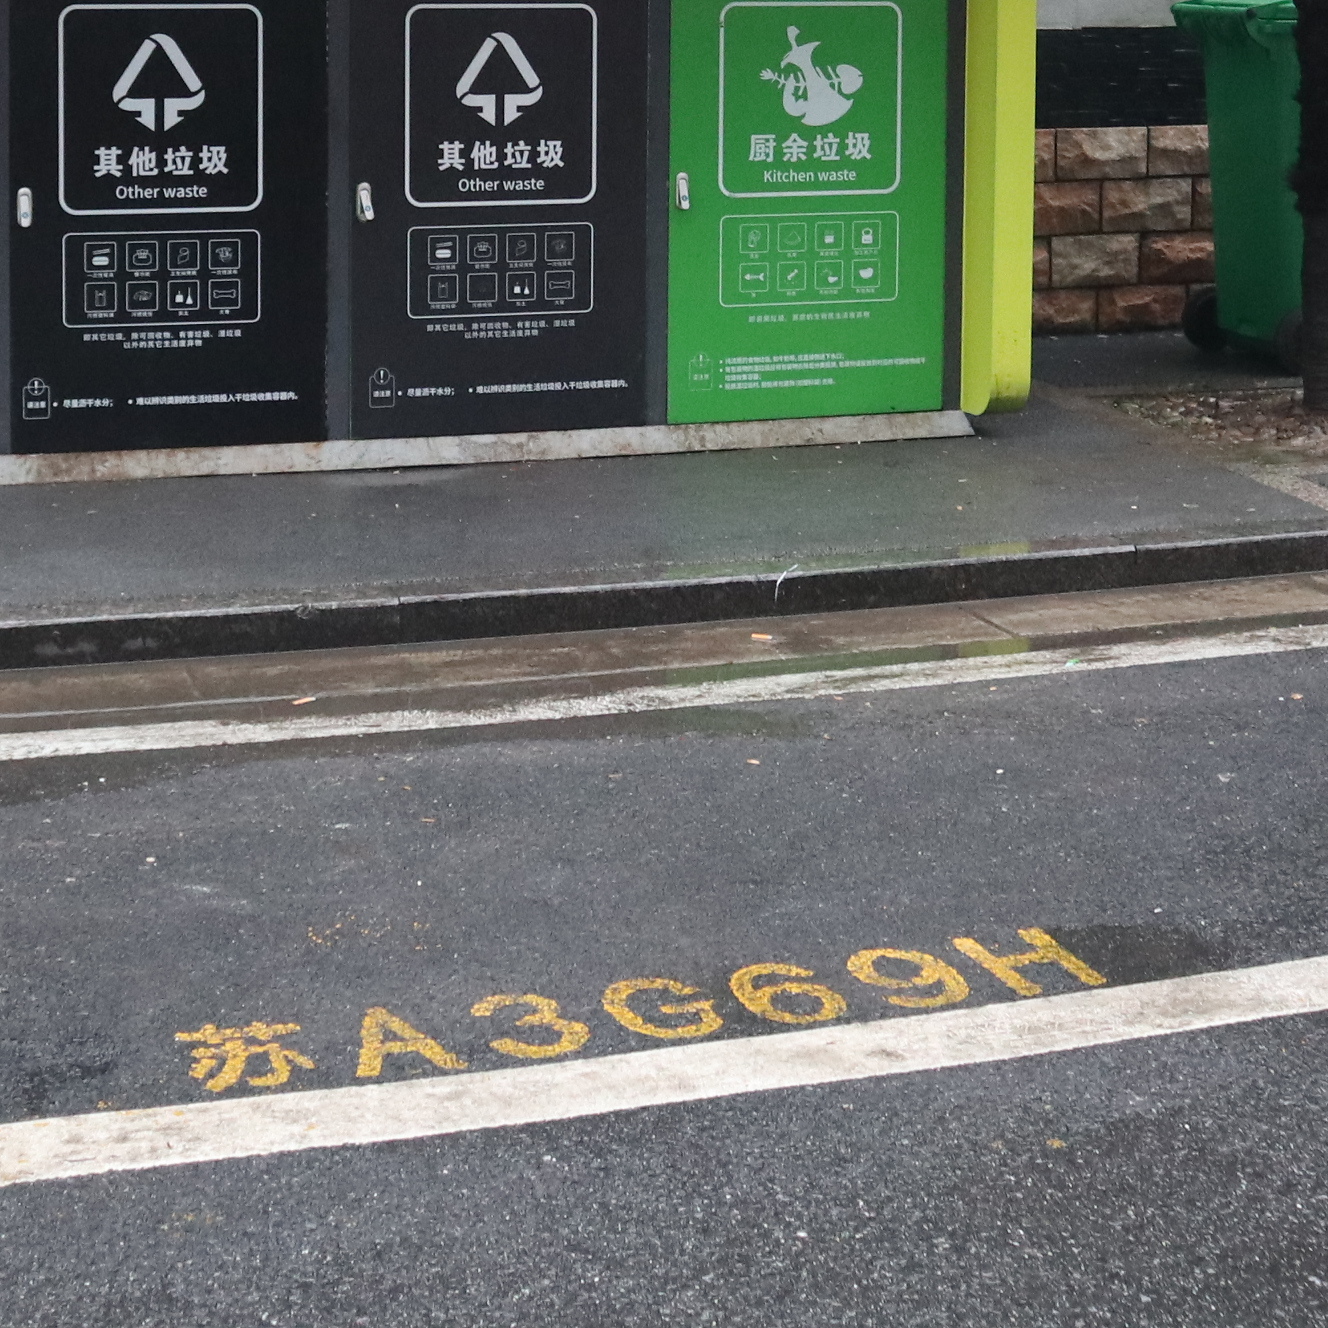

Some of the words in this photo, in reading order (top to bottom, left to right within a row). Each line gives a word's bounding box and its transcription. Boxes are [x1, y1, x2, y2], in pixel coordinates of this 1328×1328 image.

[93, 144, 229, 178] 其他垃圾
[437, 139, 565, 171] 其他垃圾
[748, 131, 872, 163] 厨余垃圾
[458, 177, 500, 192] Other
[502, 177, 545, 191] waste
[763, 168, 815, 183] Kitchen
[817, 169, 857, 182] waste
[115, 184, 161, 200] Other
[162, 184, 208, 199] waste
[174, 926, 1107, 1093] 苏A3G69H
